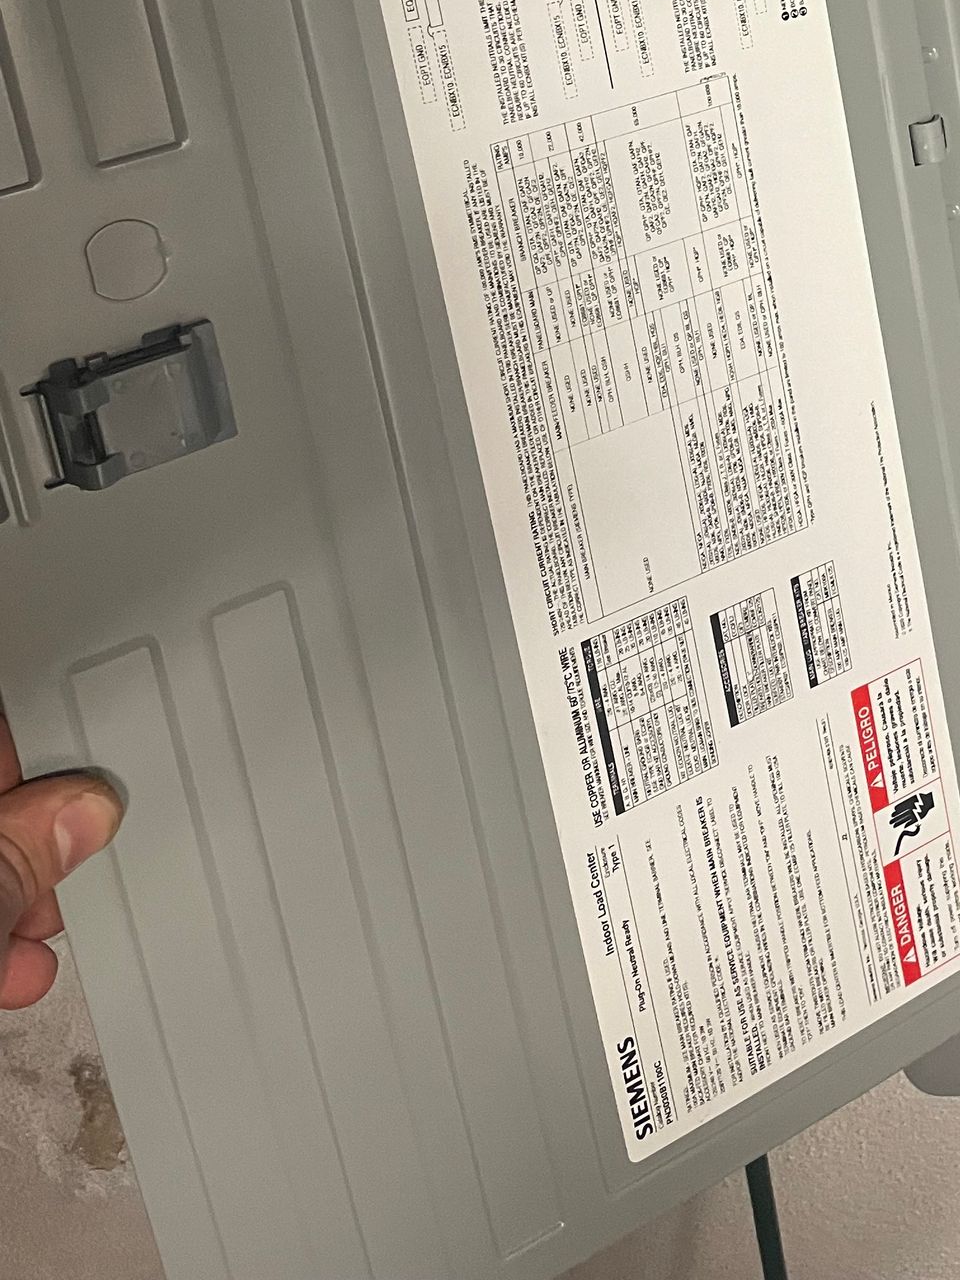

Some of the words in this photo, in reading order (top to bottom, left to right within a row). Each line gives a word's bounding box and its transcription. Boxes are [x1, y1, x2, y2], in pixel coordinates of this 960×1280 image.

[574, 2, 584, 21] GND
[612, 12, 624, 34] EQPT
[577, 20, 589, 43] EQPT
[414, 43, 426, 62] GND
[418, 61, 431, 86] EQPT
[527, 510, 539, 540] RATING
[533, 539, 547, 578] CURRENT
[542, 578, 554, 609] CIRCUIT
[548, 609, 559, 636] SHORT
[557, 646, 571, 672] WIRE
[570, 707, 588, 756] ALUMINUM
[888, 704, 897, 729] graves
[856, 704, 879, 771] PELIGRO
[891, 730, 902, 761] lesiones
[580, 755, 592, 772] OR
[584, 770, 600, 809] COPPER
[889, 768, 900, 794] Voltaje
[592, 807, 604, 828] USE
[697, 805, 711, 848] BREAKER
[584, 850, 601, 890] Center
[598, 845, 611, 878] Enclosure
[608, 849, 621, 872] Type
[705, 847, 716, 871] MAIN
[710, 870, 721, 898] WHEN
[592, 888, 607, 919] Load
[890, 882, 911, 947] DANGER
[598, 918, 614, 956] Indoor
[620, 917, 634, 946] Ready
[715, 897, 732, 948] EQUIPMENT
[626, 945, 639, 978] Neutral
[726, 947, 739, 985] SERVICE
[633, 976, 648, 1012] Plug-On
[733, 984, 742, 998] AS
[735, 996, 746, 1016] USE
[739, 1015, 749, 1035] FOR
[743, 1034, 757, 1076] SUITABLE
[750, 1022, 766, 1071] INSTALLED.
[616, 1033, 653, 1142] SIEMENS
[653, 1058, 673, 1126] PN3030B1100C
